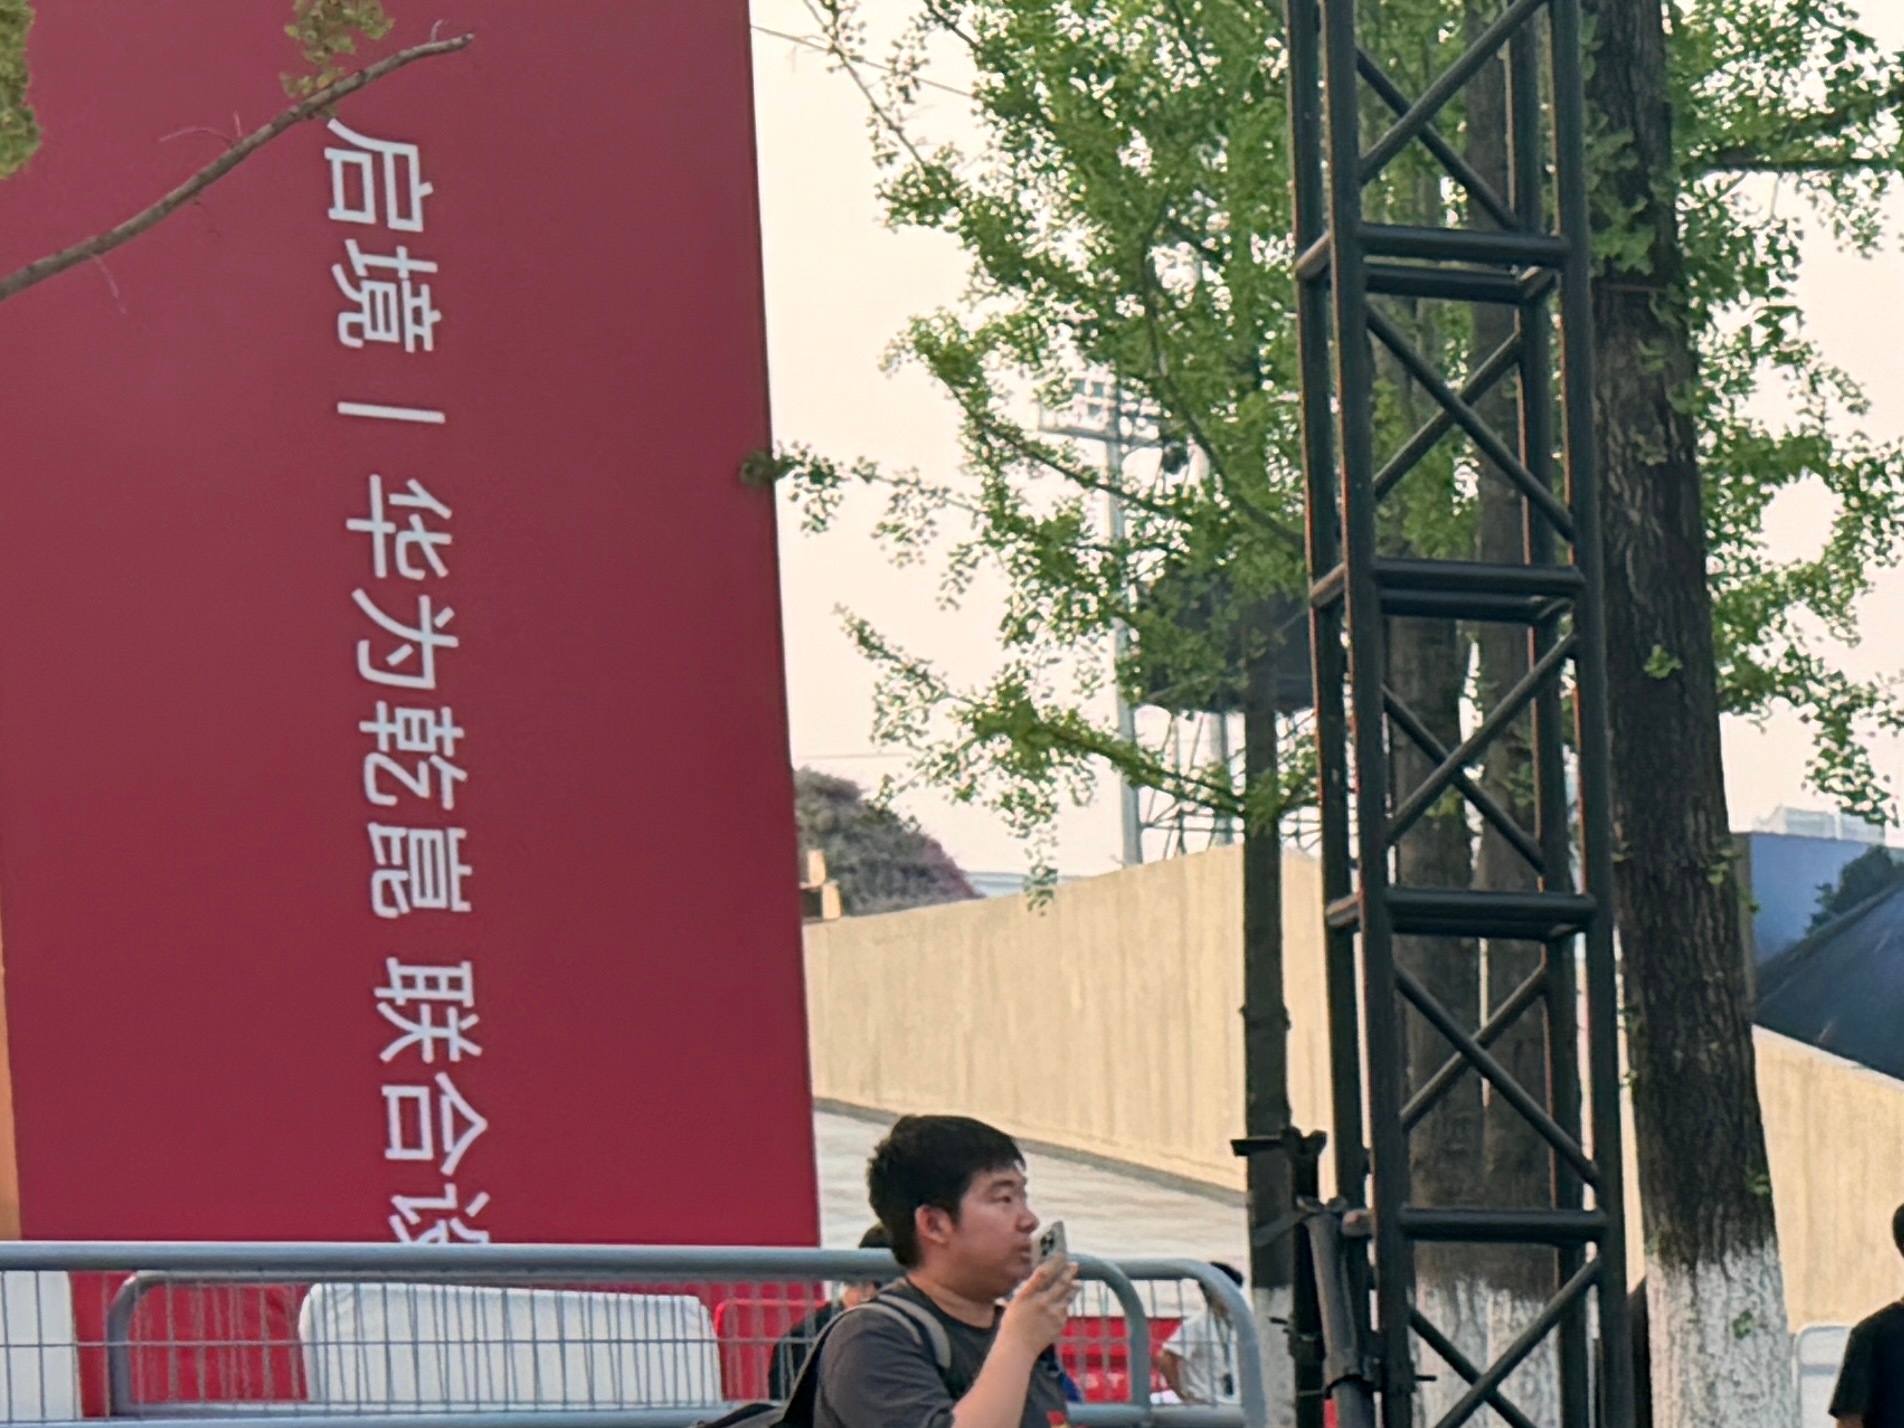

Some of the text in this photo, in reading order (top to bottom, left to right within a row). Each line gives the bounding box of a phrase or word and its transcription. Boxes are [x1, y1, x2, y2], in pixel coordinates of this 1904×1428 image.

[324, 117, 442, 353] 启境
[345, 473, 473, 919] 华为乾崑
